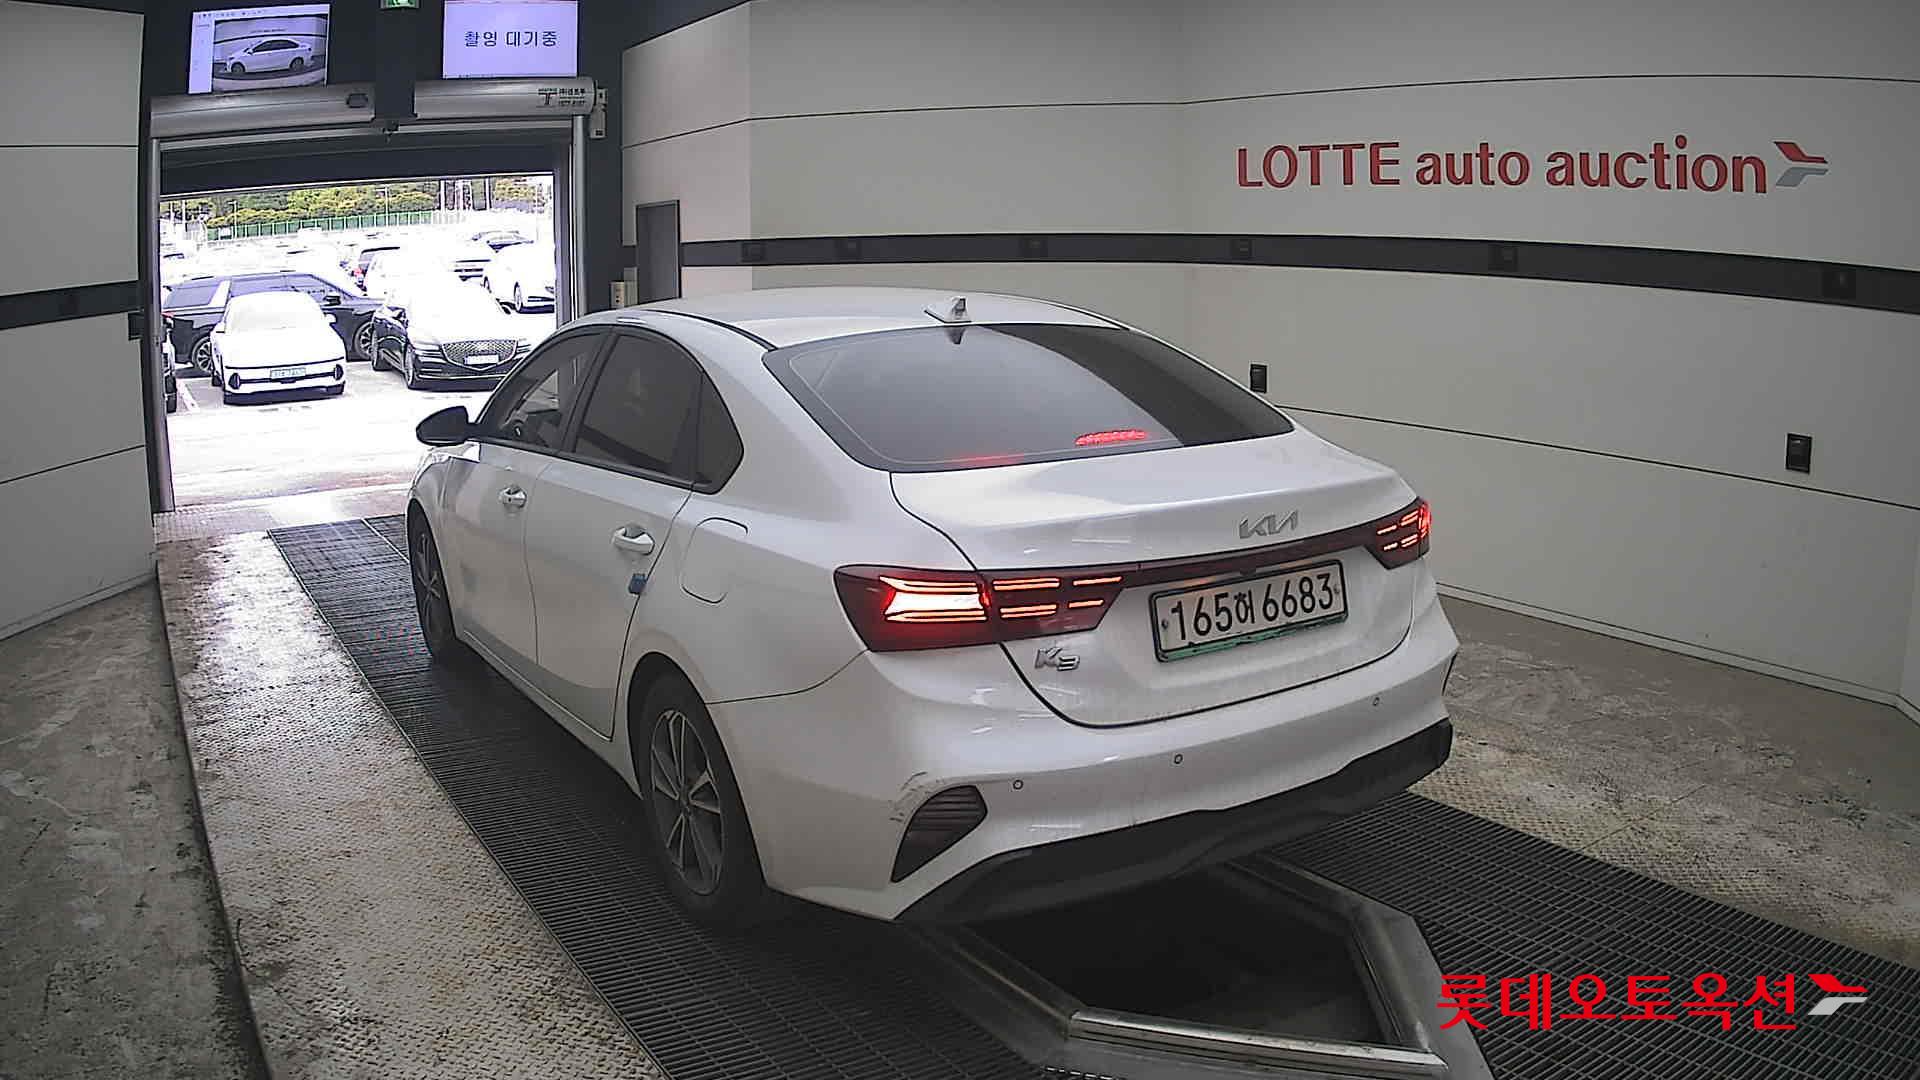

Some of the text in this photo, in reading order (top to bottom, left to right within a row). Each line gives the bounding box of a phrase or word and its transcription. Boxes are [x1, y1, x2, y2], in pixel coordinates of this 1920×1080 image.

[464, 31, 558, 47] 촬영 대기중
[1236, 134, 1767, 194] LOTTE auto auction
[1239, 509, 1298, 540] KIA
[1034, 647, 1080, 672] K3
